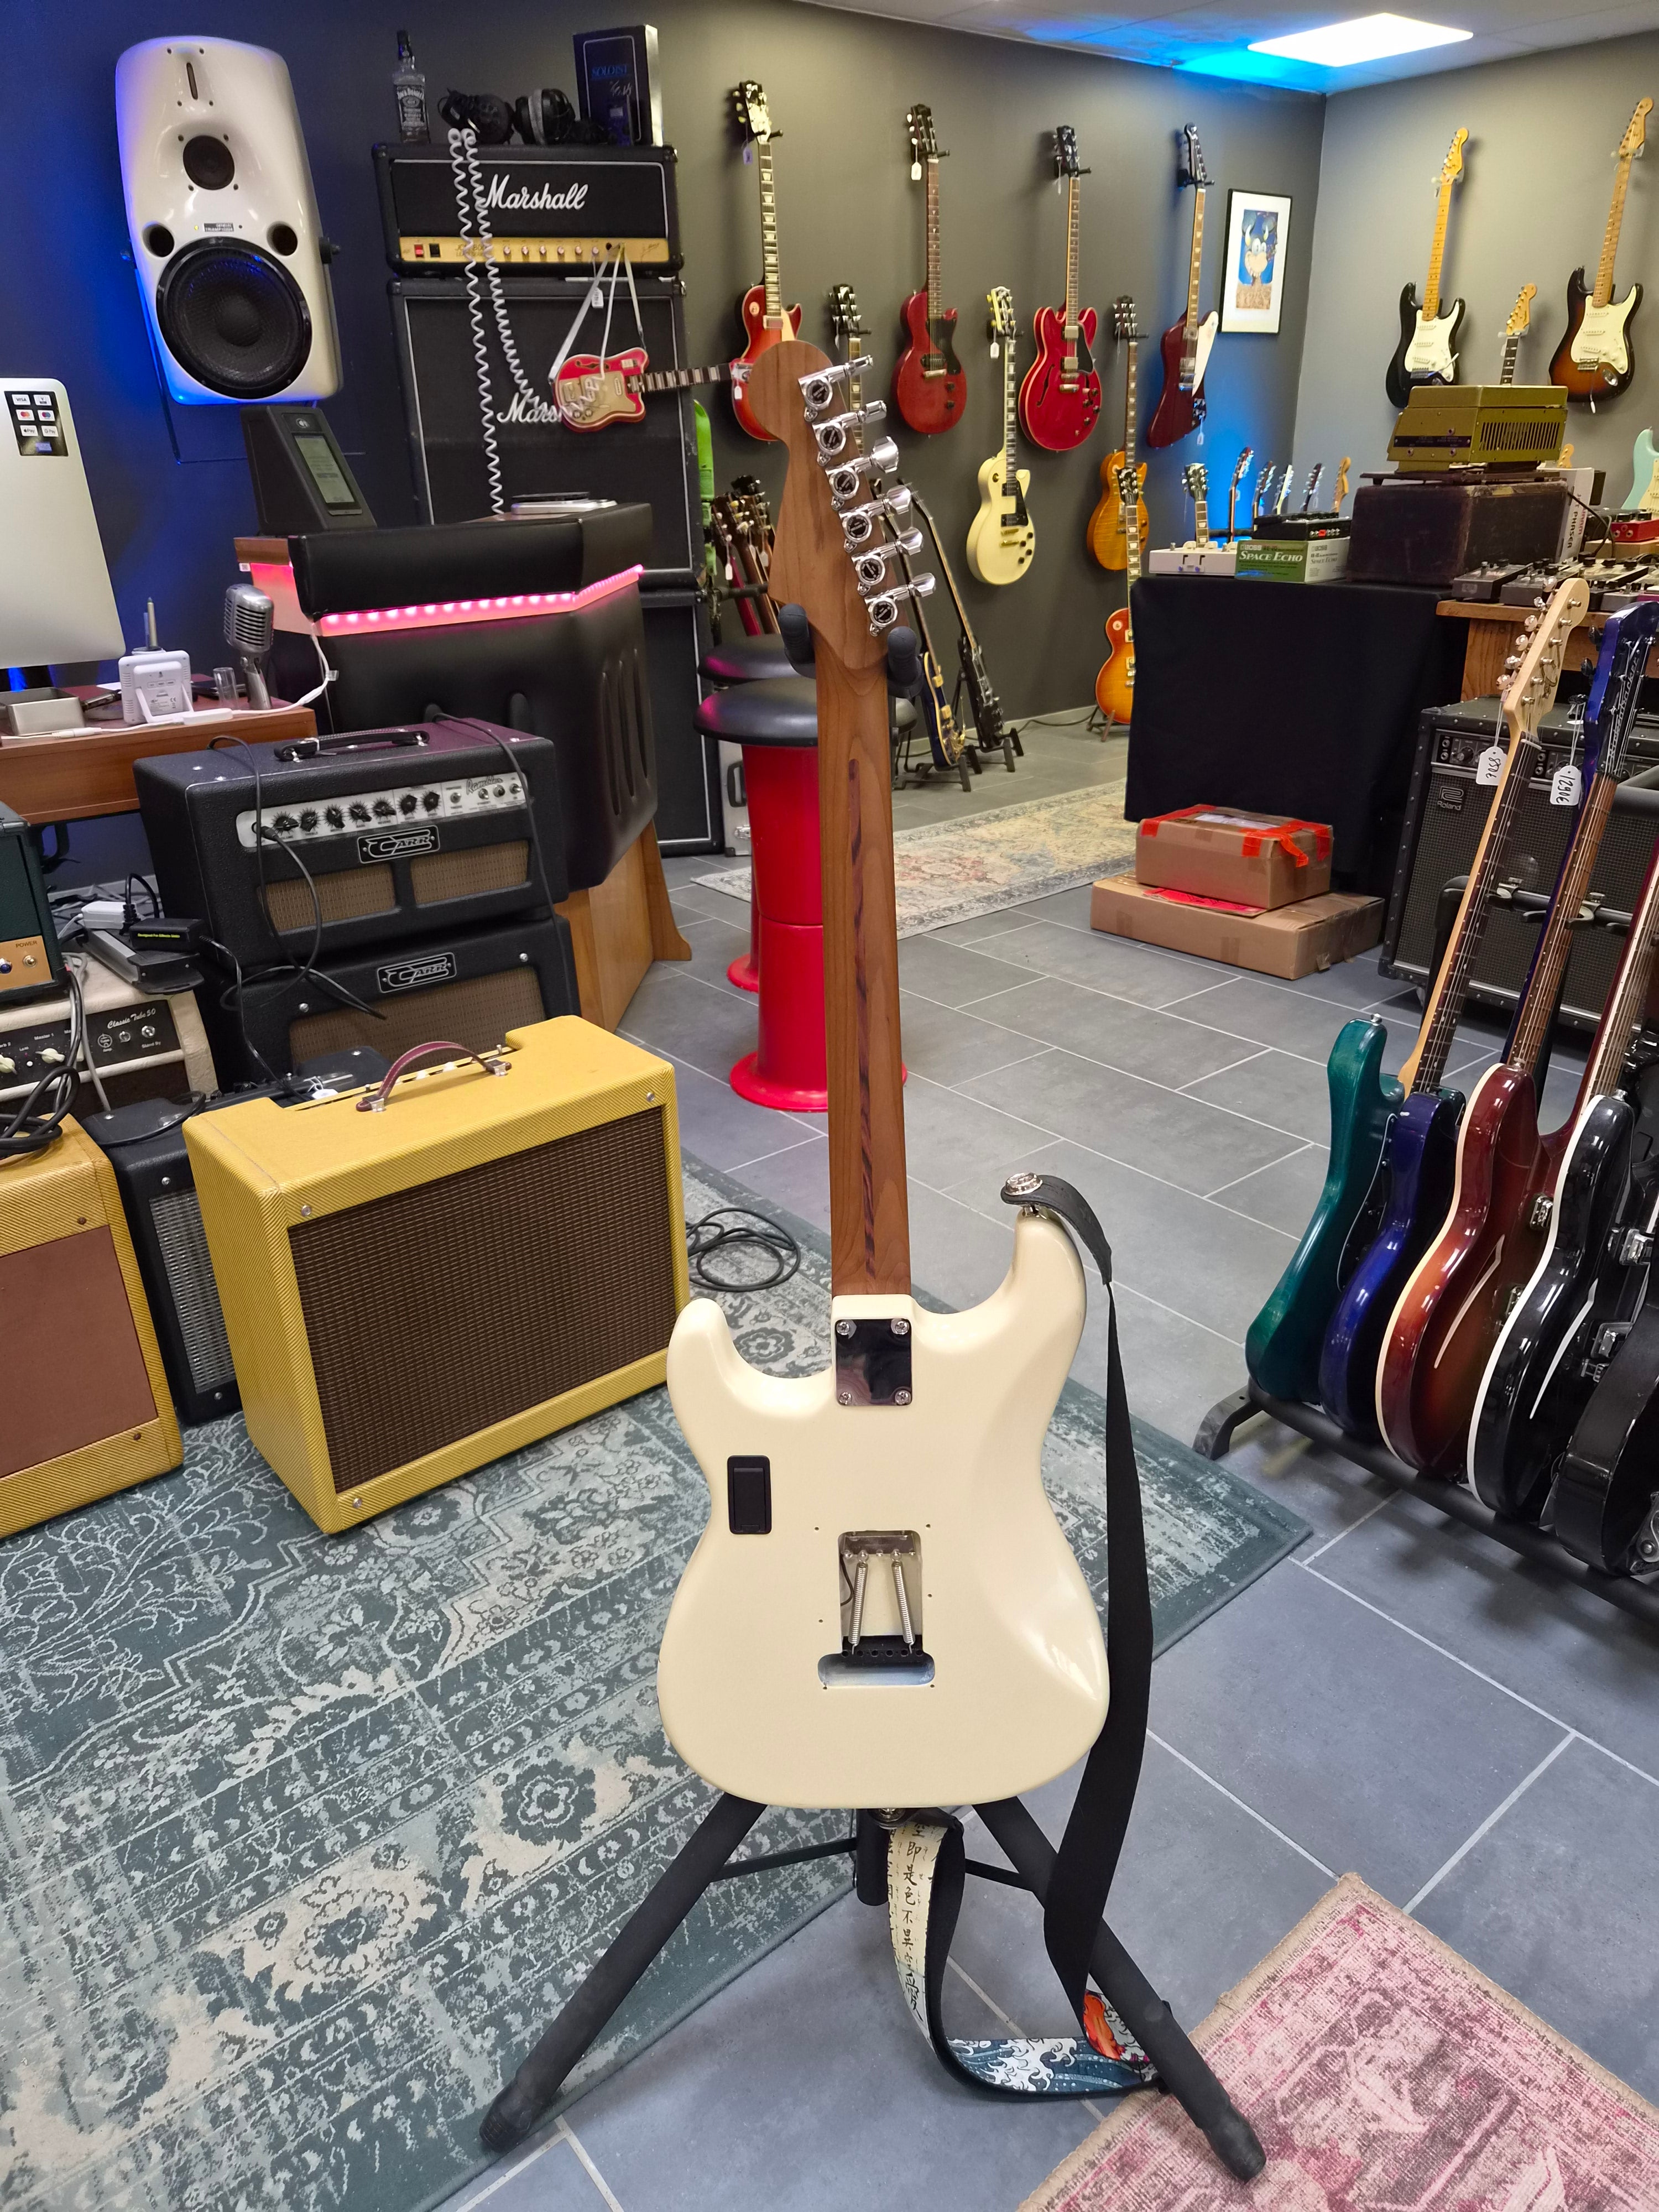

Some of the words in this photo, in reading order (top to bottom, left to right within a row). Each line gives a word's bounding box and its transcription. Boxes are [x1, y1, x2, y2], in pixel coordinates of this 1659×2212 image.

[480, 174, 588, 210] Marshall
[497, 392, 562, 422] Mars
[1567, 511, 1578, 549] PHASER
[1239, 550, 1272, 560] SPACE
[1273, 551, 1303, 562] ECHO
[1485, 757, 1501, 779] 850€
[466, 775, 504, 795] Rambler
[1556, 775, 1575, 804] 1290€
[1437, 800, 1462, 811] Roland
[107, 1018, 131, 1029] Classic
[131, 1011, 146, 1021] Tube
[147, 1008, 156, 1016] 50
